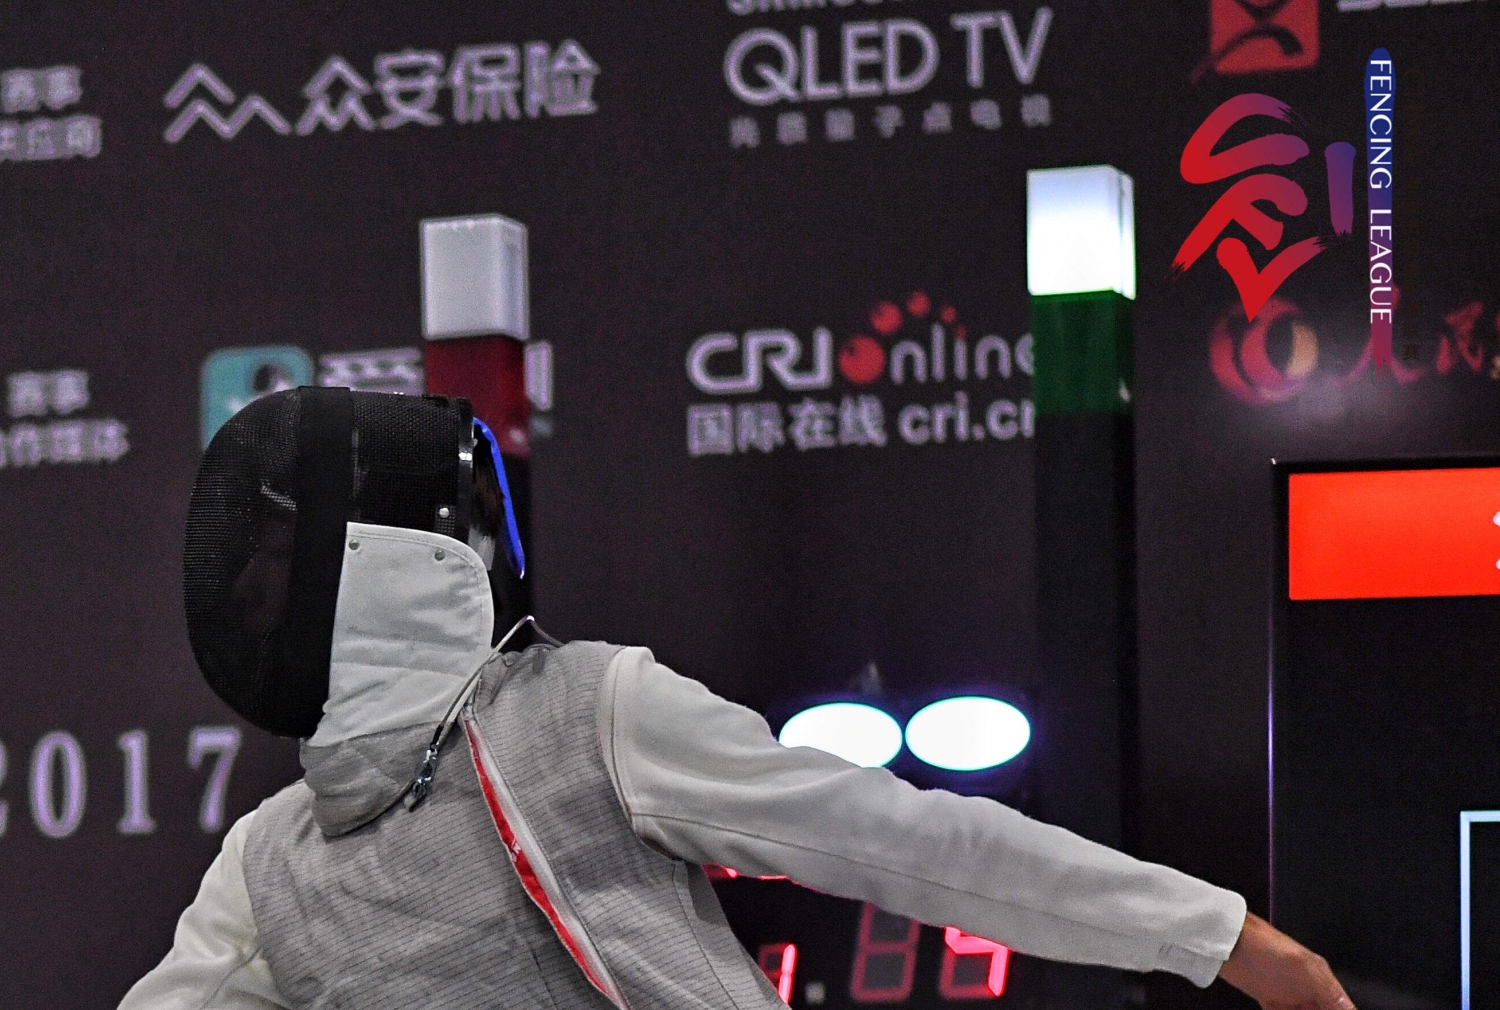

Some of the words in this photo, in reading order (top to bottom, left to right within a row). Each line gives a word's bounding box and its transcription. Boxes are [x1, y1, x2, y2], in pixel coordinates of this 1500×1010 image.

[295, 38, 600, 135] 众安保险
[723, 18, 940, 106] QLED
[950, 6, 1053, 89] TV
[686, 326, 834, 395] CRI
[687, 394, 886, 456] 国际在线
